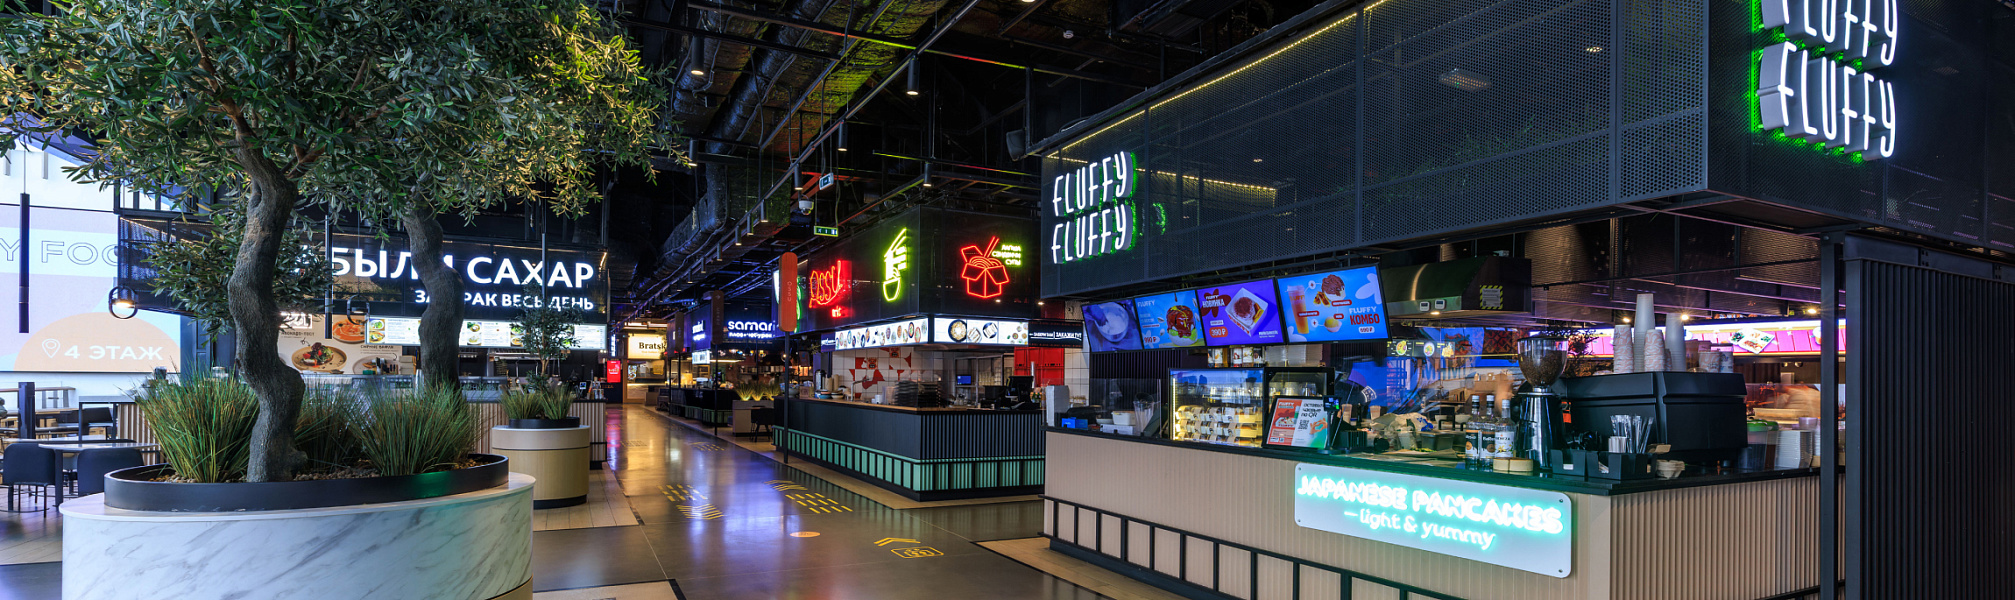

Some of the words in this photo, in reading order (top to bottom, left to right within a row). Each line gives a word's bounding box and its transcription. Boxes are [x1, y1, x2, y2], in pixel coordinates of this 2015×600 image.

[1782, 0, 1898, 66] UFFY
[1777, 41, 1896, 158] FLUFFY
[1052, 151, 1128, 217] FLUFFY
[1051, 204, 1128, 265] FLUFFY
[466, 256, 594, 289] САХАР
[414, 289, 498, 307] ЗРАК
[1349, 306, 1377, 314] FLUFFY
[1350, 313, 1380, 325] КОМБО
[64, 345, 81, 359] 4
[88, 345, 164, 361] ЭТАЖ
[1297, 475, 1408, 510] JAPANESE
[1412, 489, 1564, 535] PANCAKES
[1403, 515, 1417, 533] &
[1421, 521, 1496, 551] yummy
